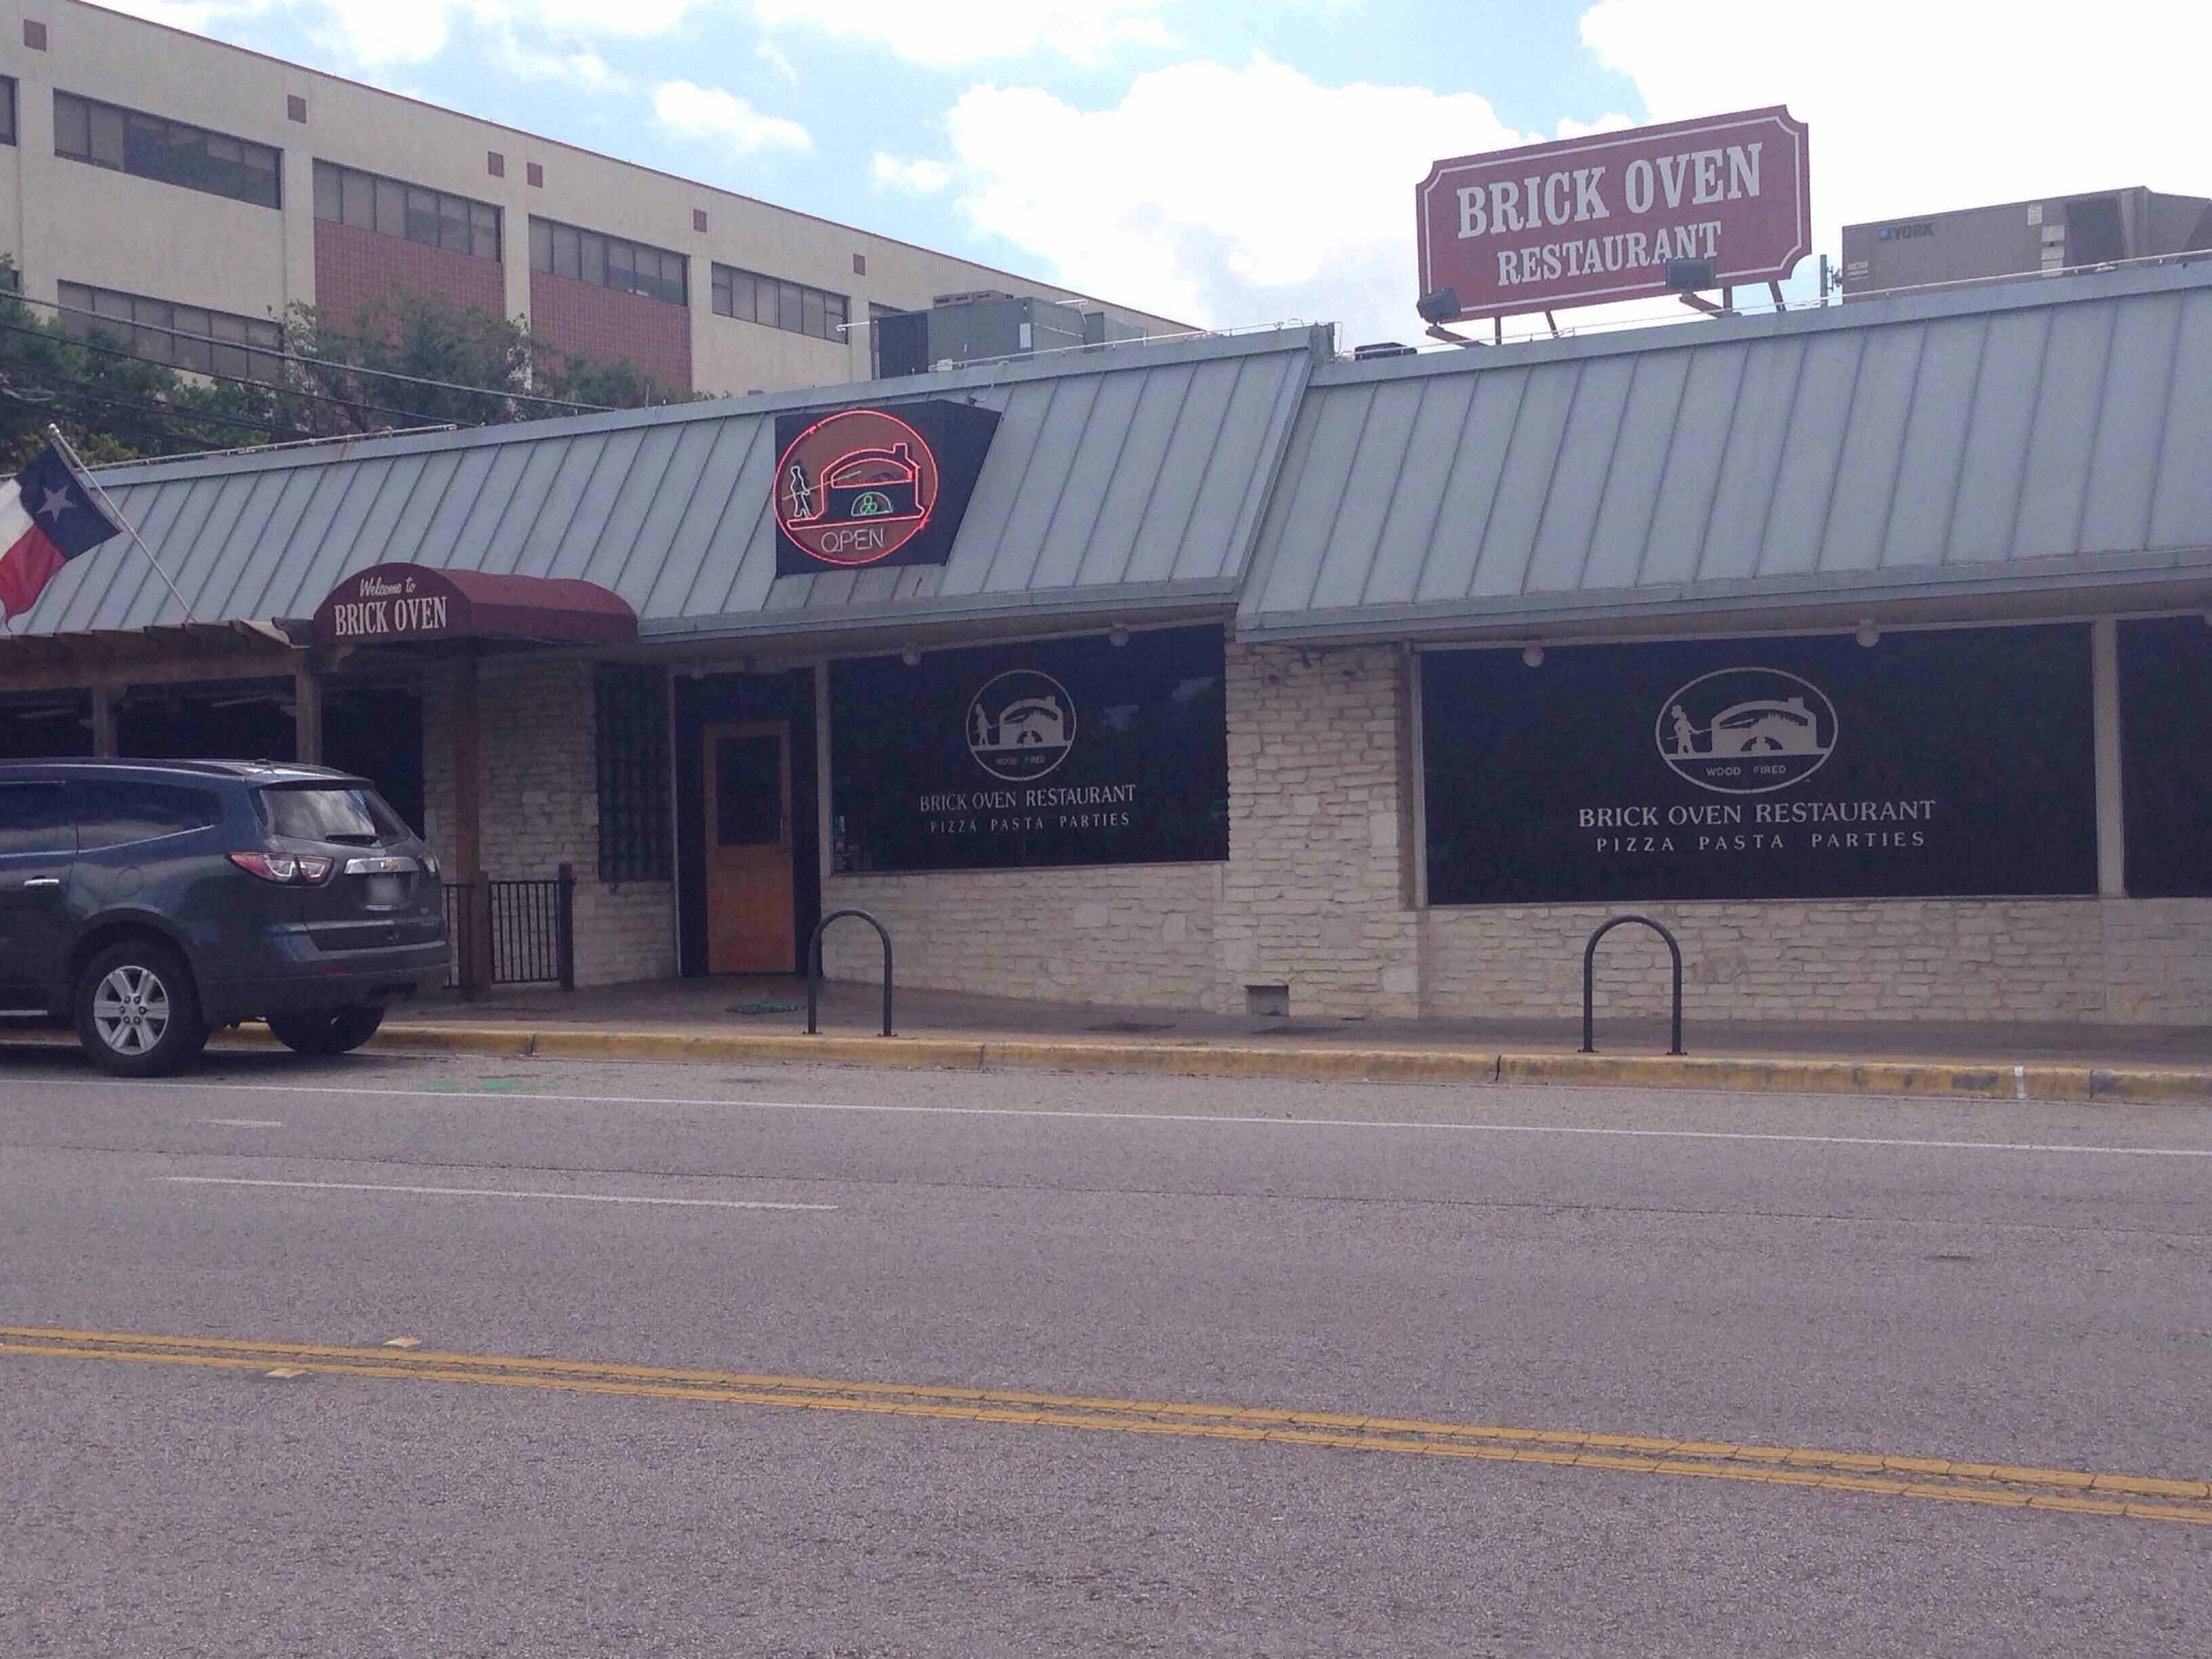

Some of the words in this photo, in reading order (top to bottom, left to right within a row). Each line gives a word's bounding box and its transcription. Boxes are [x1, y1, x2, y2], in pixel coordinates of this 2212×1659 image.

[1456, 167, 1610, 239] BRICK
[1626, 142, 1762, 215] OVEN
[1497, 221, 1721, 286] RESTAURANT
[821, 527, 884, 552] OPEN
[359, 577, 402, 597] Welcome
[406, 576, 415, 594] to
[335, 600, 389, 636] BRICK
[394, 596, 448, 631] OVEN
[1706, 766, 1741, 776] WOOD
[1753, 764, 1786, 775] FIRED
[920, 794, 967, 812] BRICK
[972, 791, 1017, 808] OVEN
[1026, 784, 1136, 806] RESTAURANT
[931, 820, 977, 834] PIZZA
[991, 817, 1044, 831] PASTA
[1059, 813, 1130, 827] PARTIES
[1579, 806, 1658, 827] BRICK
[1668, 805, 1742, 825] OVEN
[1755, 800, 1936, 823] RESTAURANT
[1596, 837, 1675, 852] PIZZA
[1698, 834, 1784, 851] PASTA
[1811, 831, 1925, 848] PARTIES
